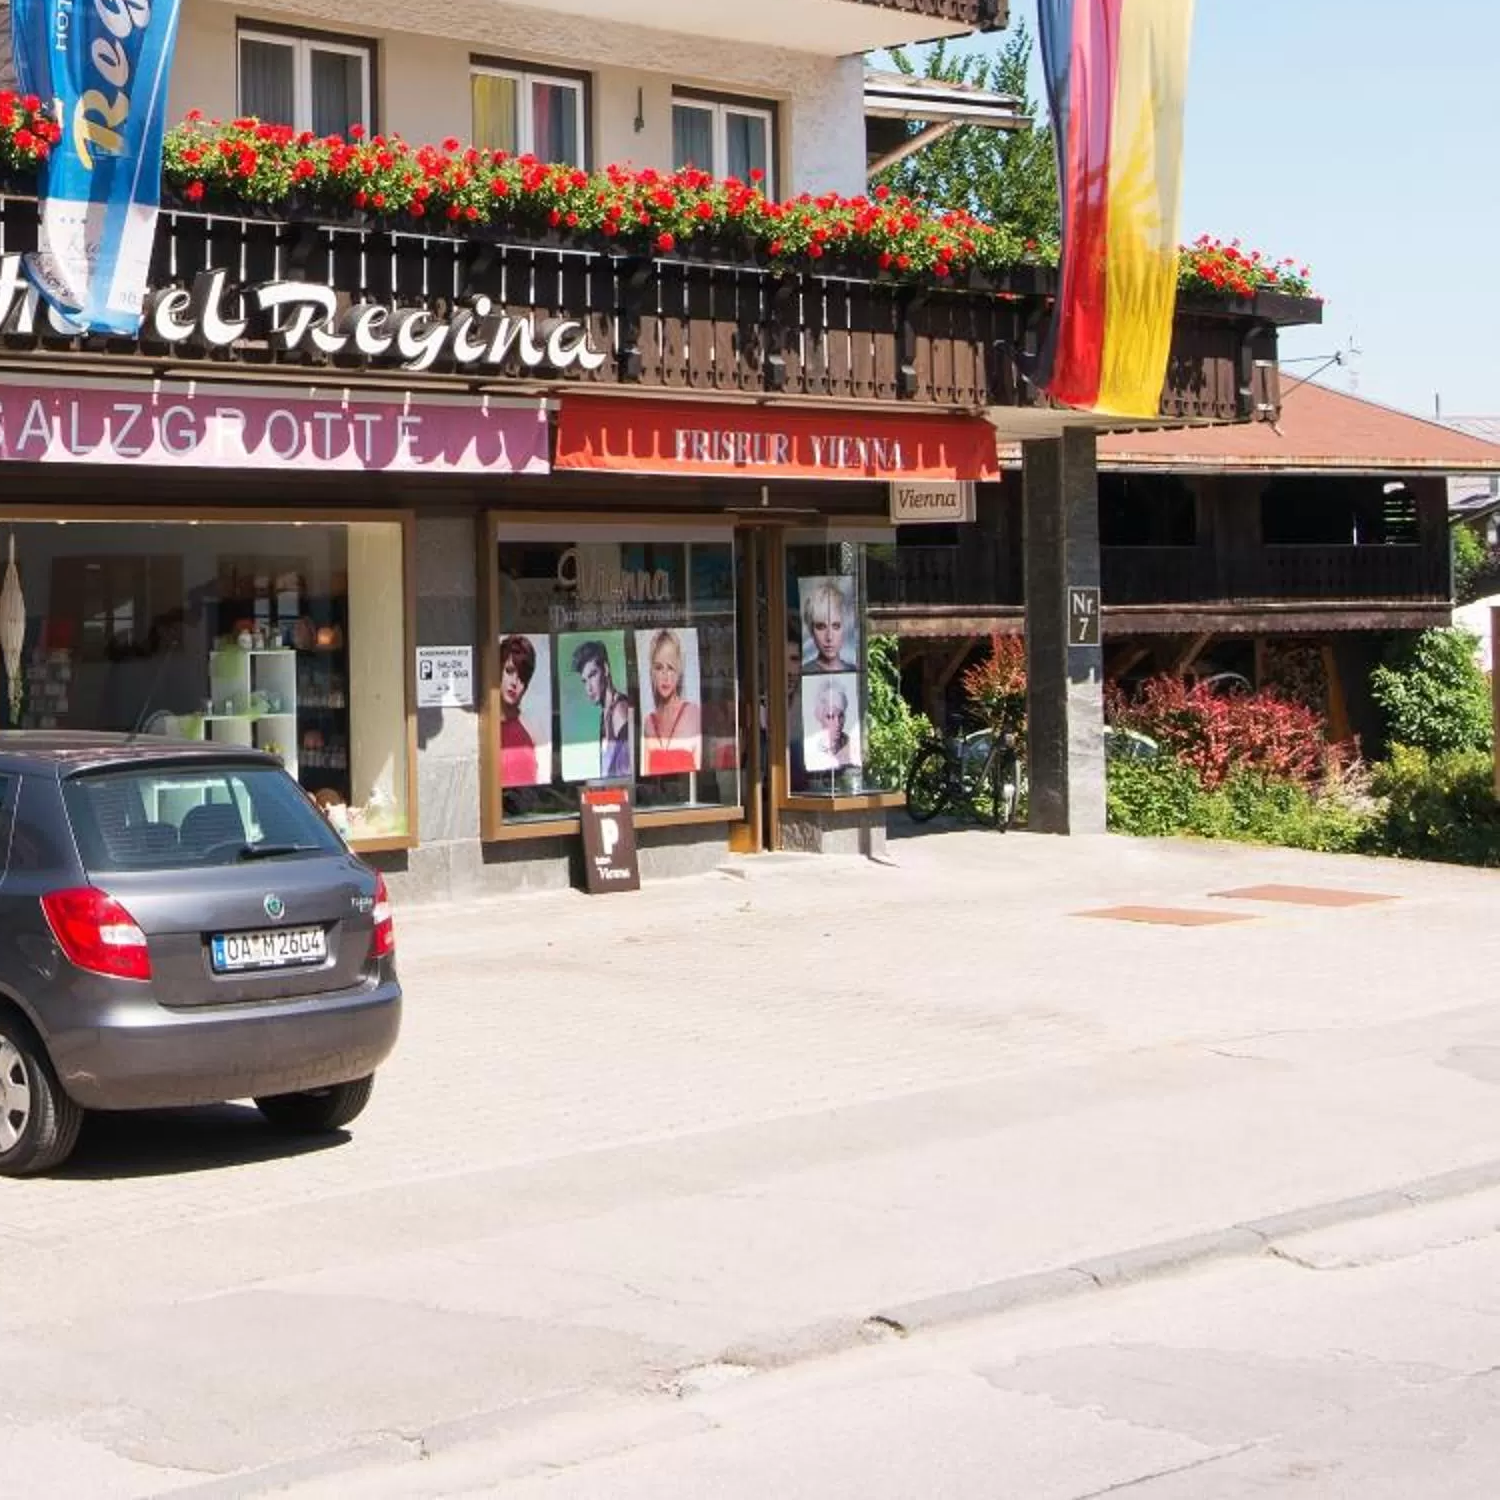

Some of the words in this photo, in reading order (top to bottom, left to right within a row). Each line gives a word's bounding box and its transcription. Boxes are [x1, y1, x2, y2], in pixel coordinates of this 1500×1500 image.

[257, 280, 607, 371] Regina
[674, 428, 789, 465] FRISEUR
[810, 433, 903, 470] VIENNA
[898, 488, 958, 510] Vienna
[1072, 592, 1097, 615] Nr.
[1079, 617, 1089, 641] 7
[228, 936, 252, 960] OA
